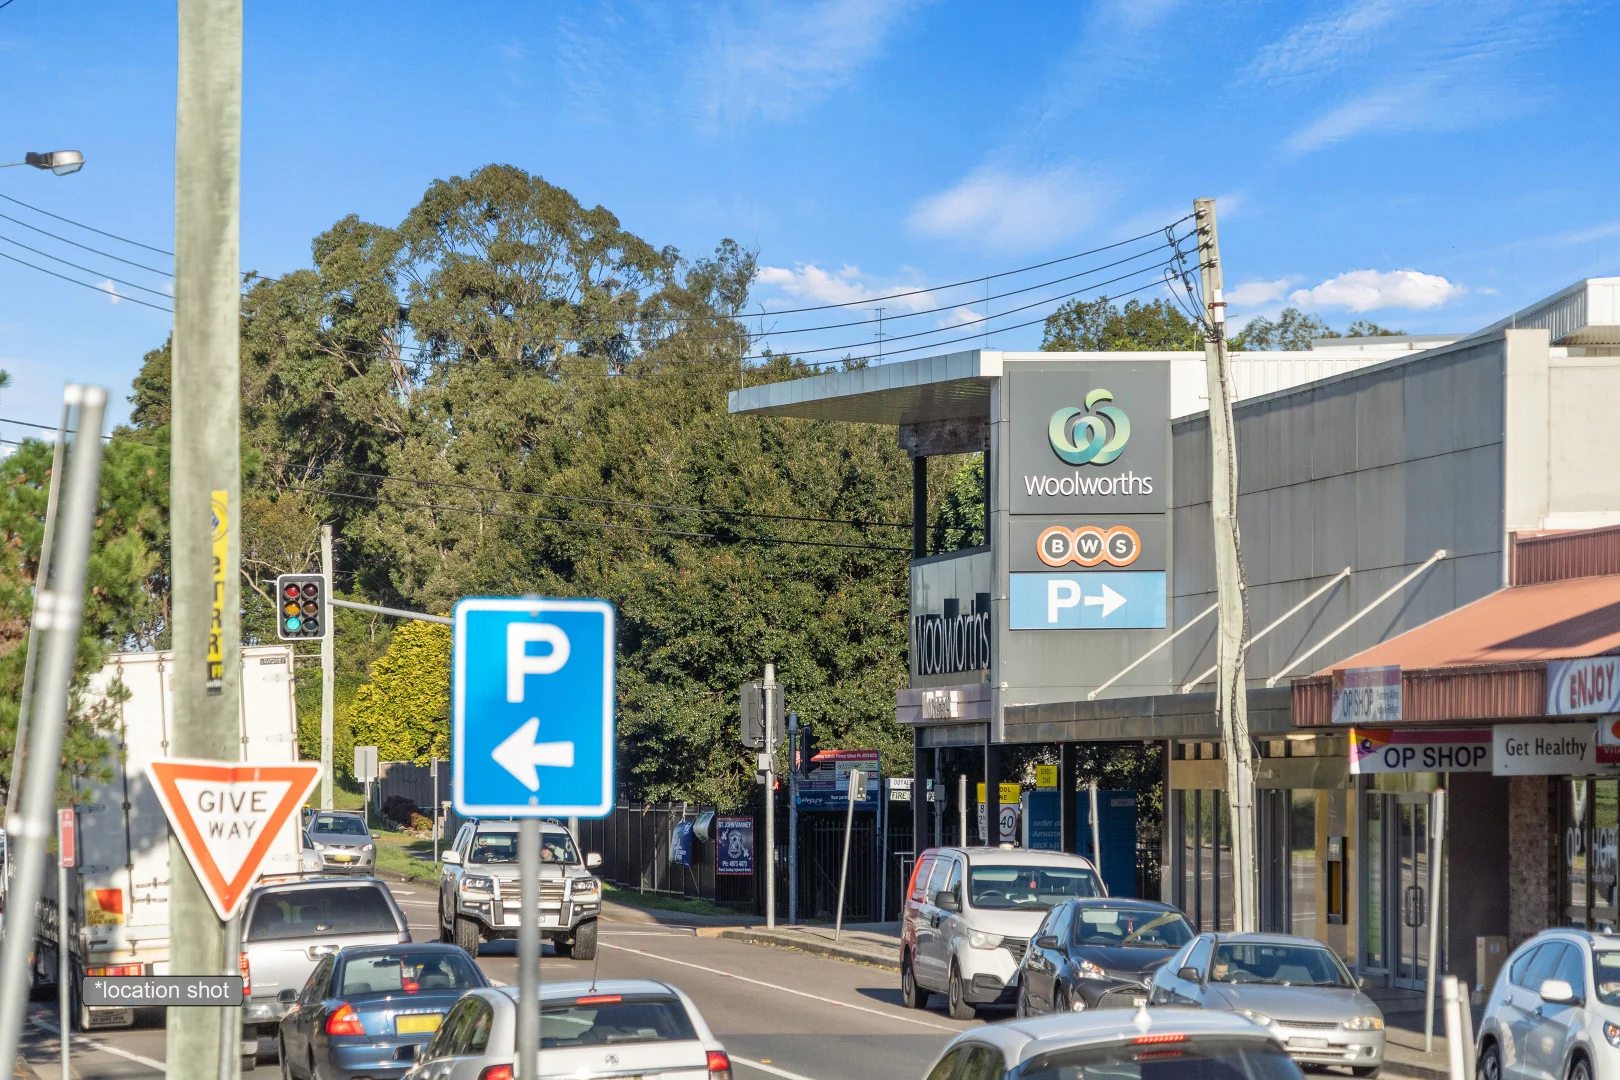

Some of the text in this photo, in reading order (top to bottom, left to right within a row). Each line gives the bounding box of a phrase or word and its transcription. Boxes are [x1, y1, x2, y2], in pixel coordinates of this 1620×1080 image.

[1024, 471, 1153, 496] Woolworths
[1052, 539, 1127, 554] BWS
[1048, 580, 1082, 623] P
[914, 611, 989, 675] Woolworths
[506, 622, 571, 703] P
[1570, 662, 1615, 710] ENJOY
[1342, 688, 1353, 718] OP
[1354, 688, 1374, 717] SHOP
[1384, 746, 1486, 769] OP SHOP
[1505, 737, 1587, 760] Get Healthy
[199, 790, 268, 814] GIVE
[891, 792, 907, 800] FIRE
[209, 820, 256, 840] WAY
[1000, 815, 1014, 829] 40
[1032, 819, 1054, 827] order
